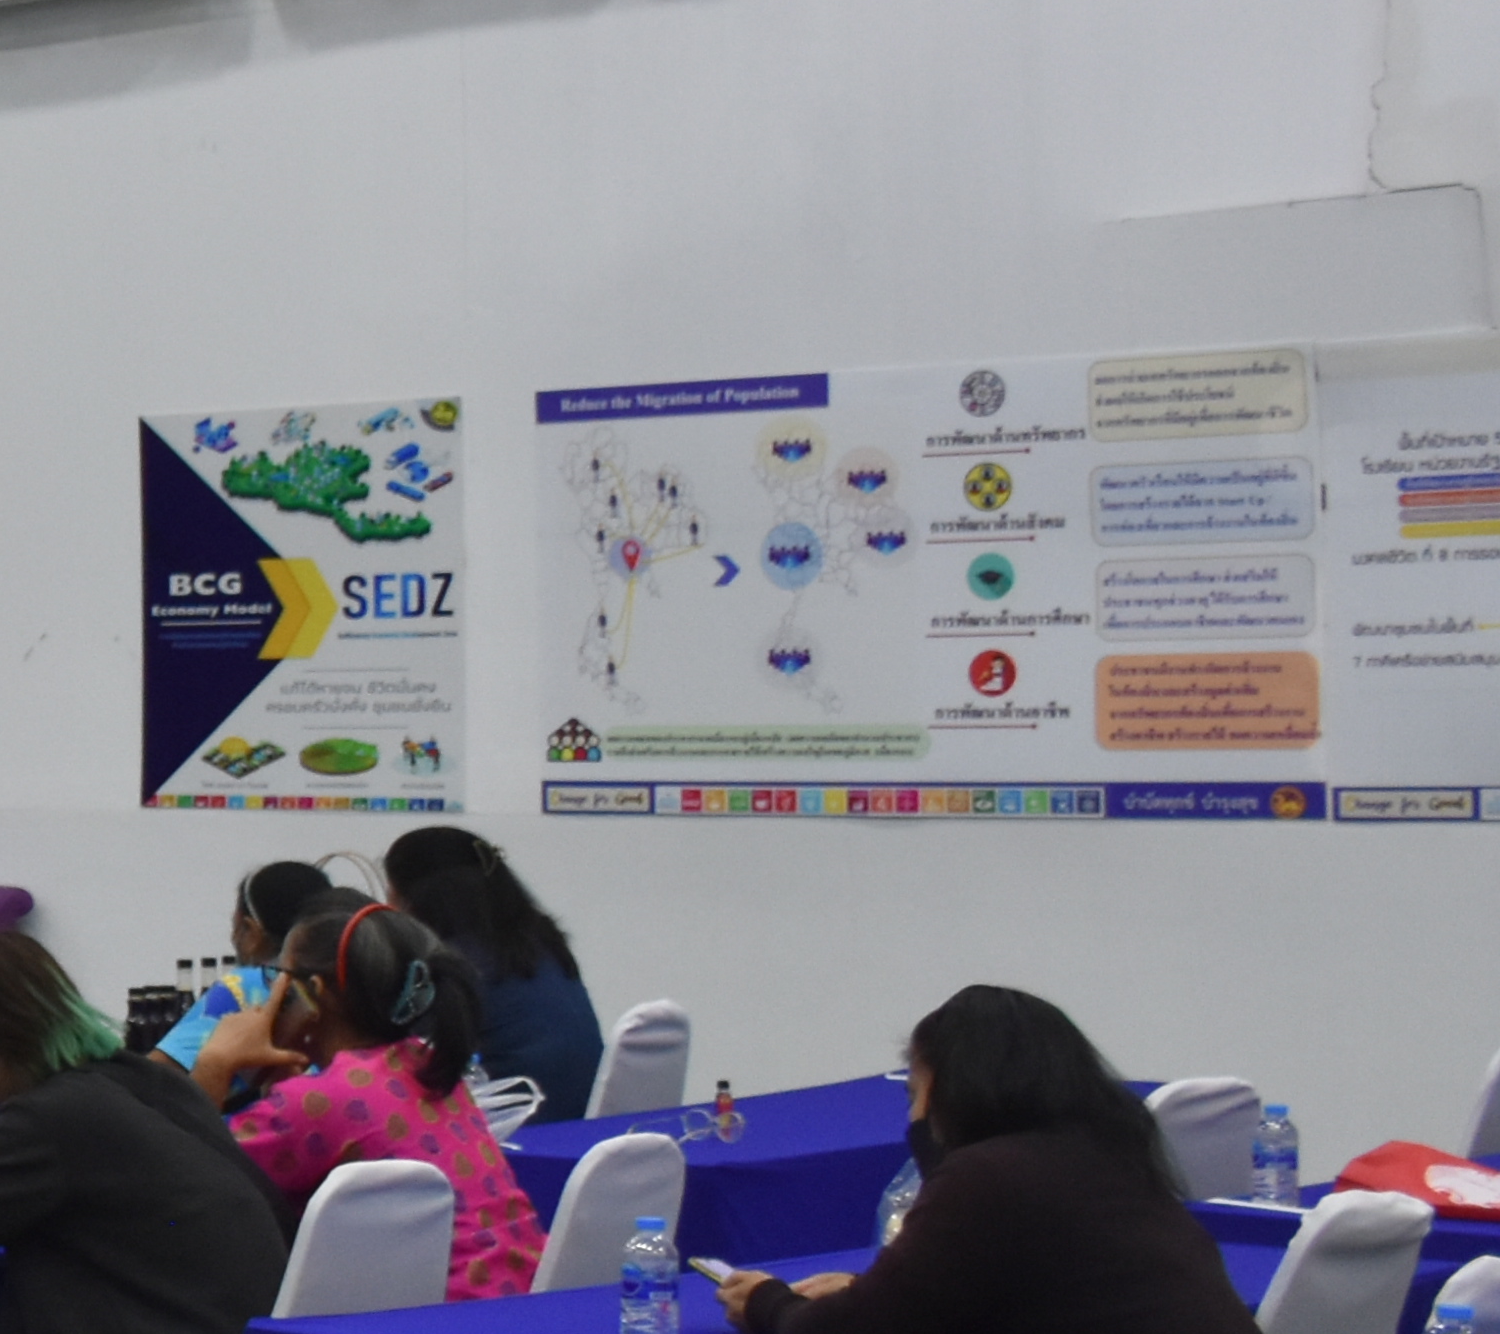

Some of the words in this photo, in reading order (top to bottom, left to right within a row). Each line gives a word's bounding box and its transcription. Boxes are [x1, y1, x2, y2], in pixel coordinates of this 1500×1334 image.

[560, 396, 608, 413] Reduce
[611, 394, 632, 409] the
[635, 390, 703, 410] Migration
[706, 389, 722, 404] of
[724, 385, 800, 405] Population
[168, 573, 243, 598] BCG
[342, 572, 455, 620] SEDZ
[151, 604, 219, 619] Economy
[223, 603, 273, 616] Model
